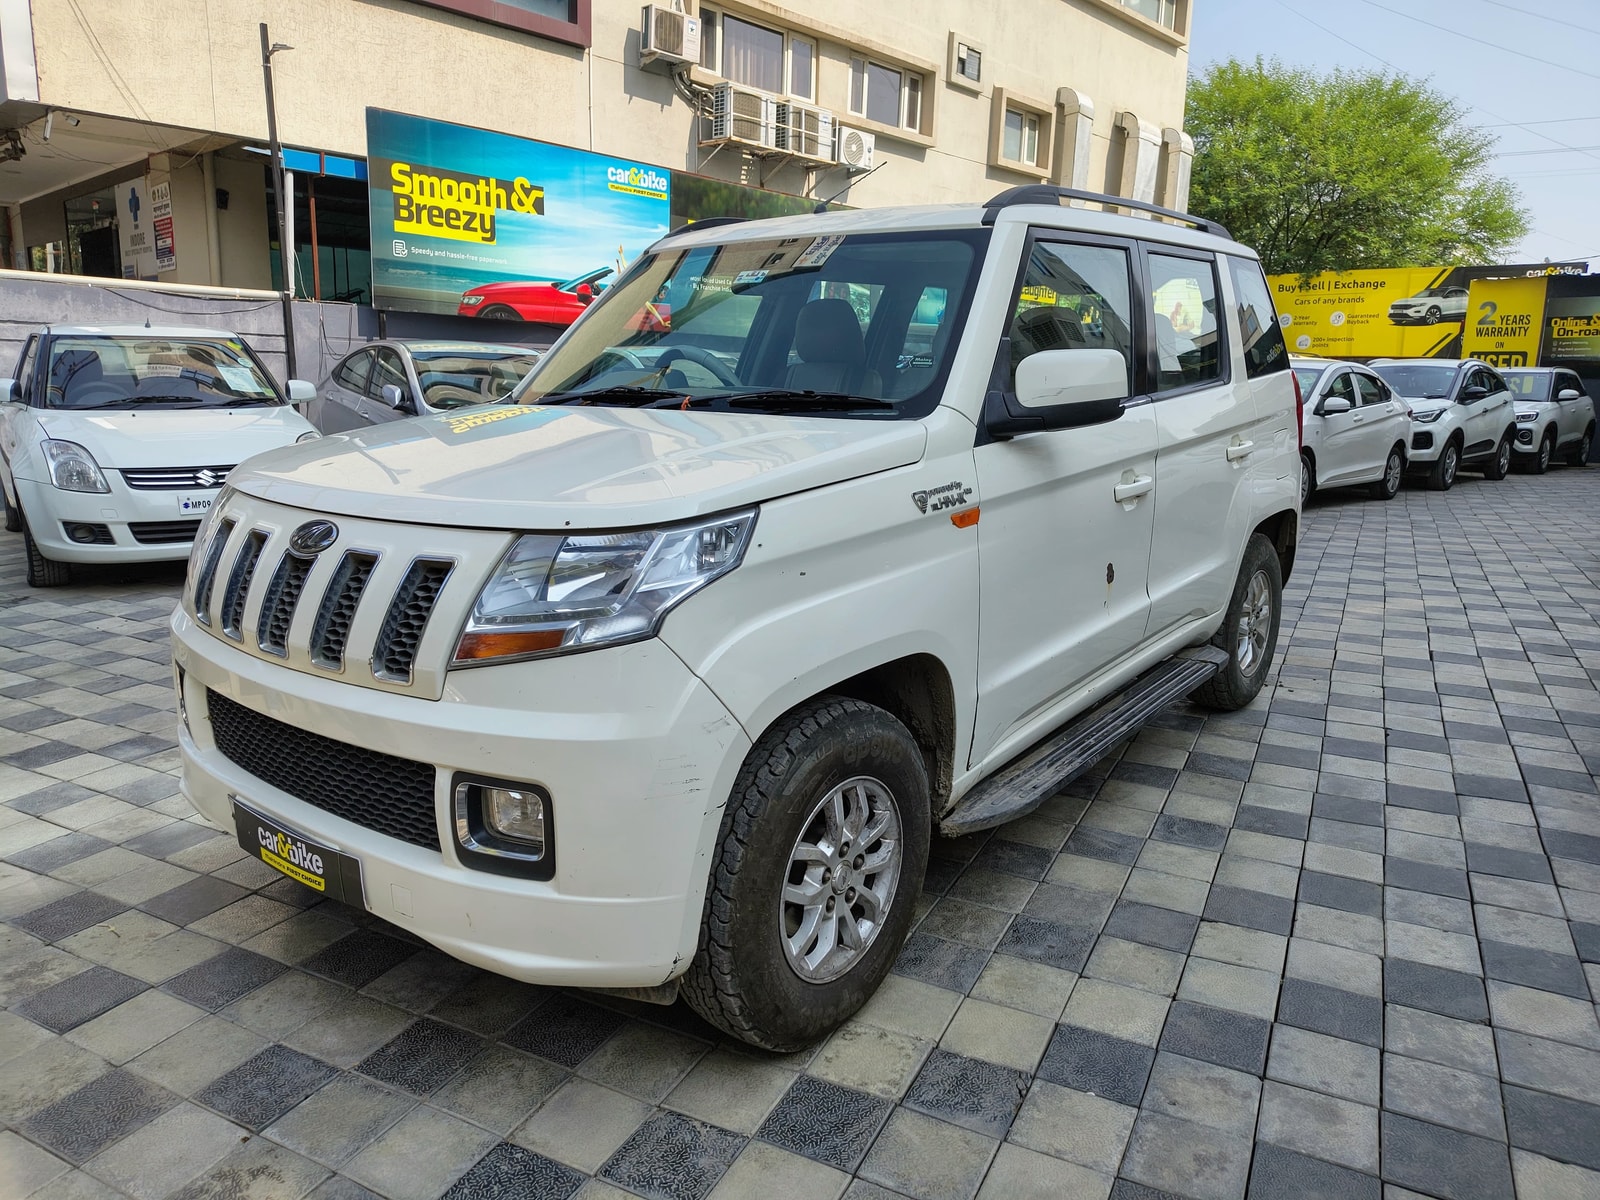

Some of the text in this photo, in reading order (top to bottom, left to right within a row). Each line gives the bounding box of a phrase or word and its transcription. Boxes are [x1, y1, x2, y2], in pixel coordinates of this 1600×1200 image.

[608, 166, 667, 191] car&bike
[391, 162, 544, 215] Smooth &
[394, 193, 496, 242] Breezy
[411, 246, 434, 257] Speedy
[434, 249, 446, 257] and
[446, 250, 478, 261] hassle-free
[1278, 283, 1297, 293] Buy
[1305, 281, 1325, 291] Sell
[1334, 279, 1386, 290] Exchange
[1294, 296, 1365, 306] Cars of any brands
[1477, 301, 1531, 326] 2 YEARS
[1551, 316, 1588, 327] Online
[1475, 326, 1530, 338] WARRANTY
[1495, 341, 1505, 349] ON
[258, 826, 323, 874] car&bike
[286, 866, 300, 877] FIRST
[301, 874, 321, 886] CHOICE
